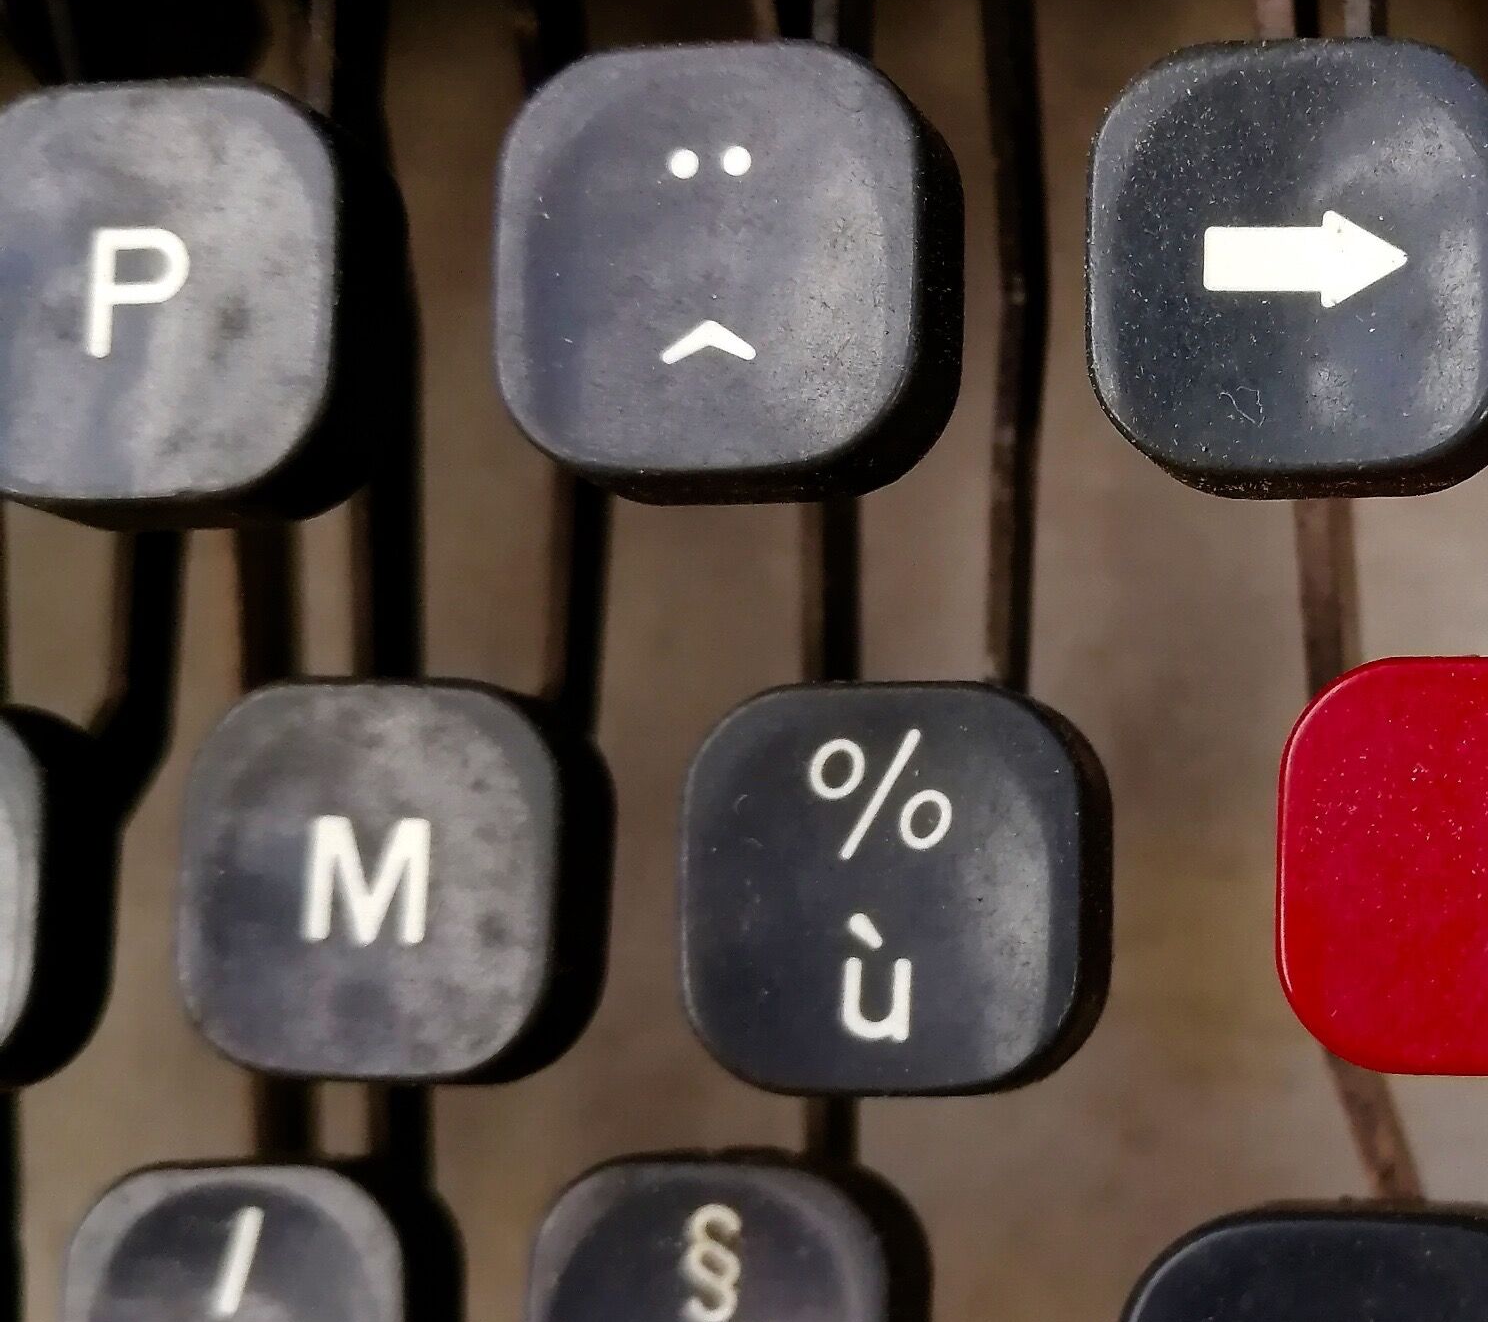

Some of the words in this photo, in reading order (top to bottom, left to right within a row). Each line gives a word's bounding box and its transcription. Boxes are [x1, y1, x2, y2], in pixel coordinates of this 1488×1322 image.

[85, 225, 192, 359] P
[808, 727, 953, 860] %
[303, 814, 432, 945] M
[841, 912, 913, 1042] ù
